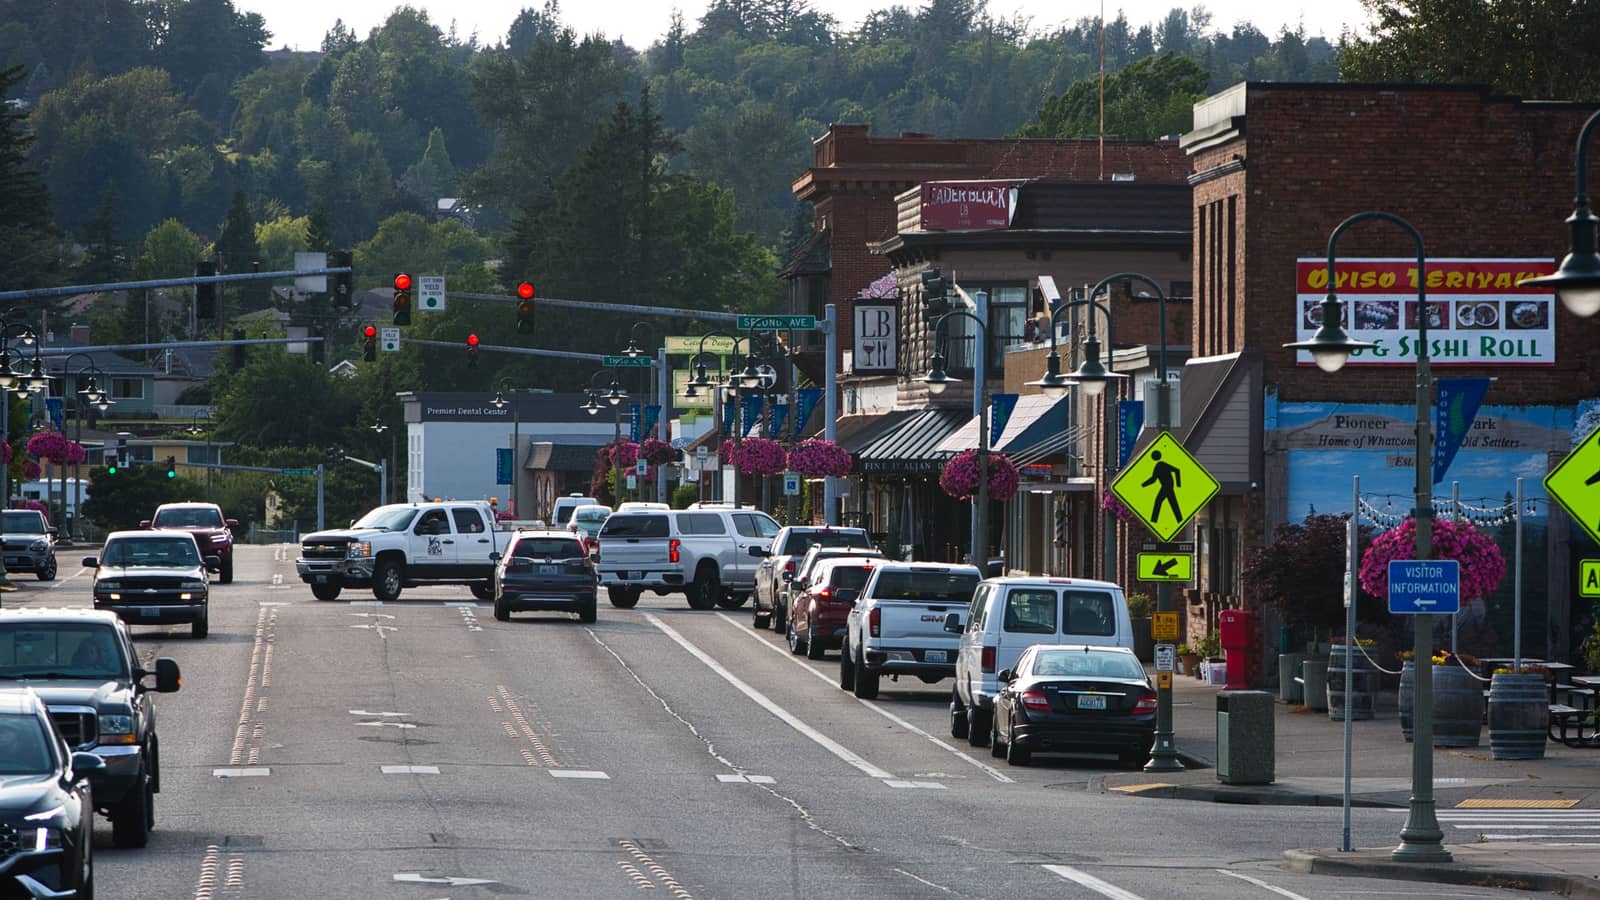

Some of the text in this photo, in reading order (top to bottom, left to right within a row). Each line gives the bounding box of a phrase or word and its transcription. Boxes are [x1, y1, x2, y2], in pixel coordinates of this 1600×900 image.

[969, 187, 1005, 208] BLOCK
[861, 310, 890, 338] LB
[1399, 335, 1468, 357] SUSHI
[1480, 335, 1542, 357] ROLL
[427, 407, 508, 415] Premier Dental Center
[1335, 415, 1497, 430] Pioneer ark
[1319, 434, 1350, 447] Home
[1352, 435, 1366, 449] of
[1368, 435, 1416, 447] Whatcom
[1481, 436, 1520, 449] Settlers
[1405, 567, 1443, 578] VISITOR
[1586, 568, 1600, 589] A
[1391, 582, 1457, 593] INFORMATION
